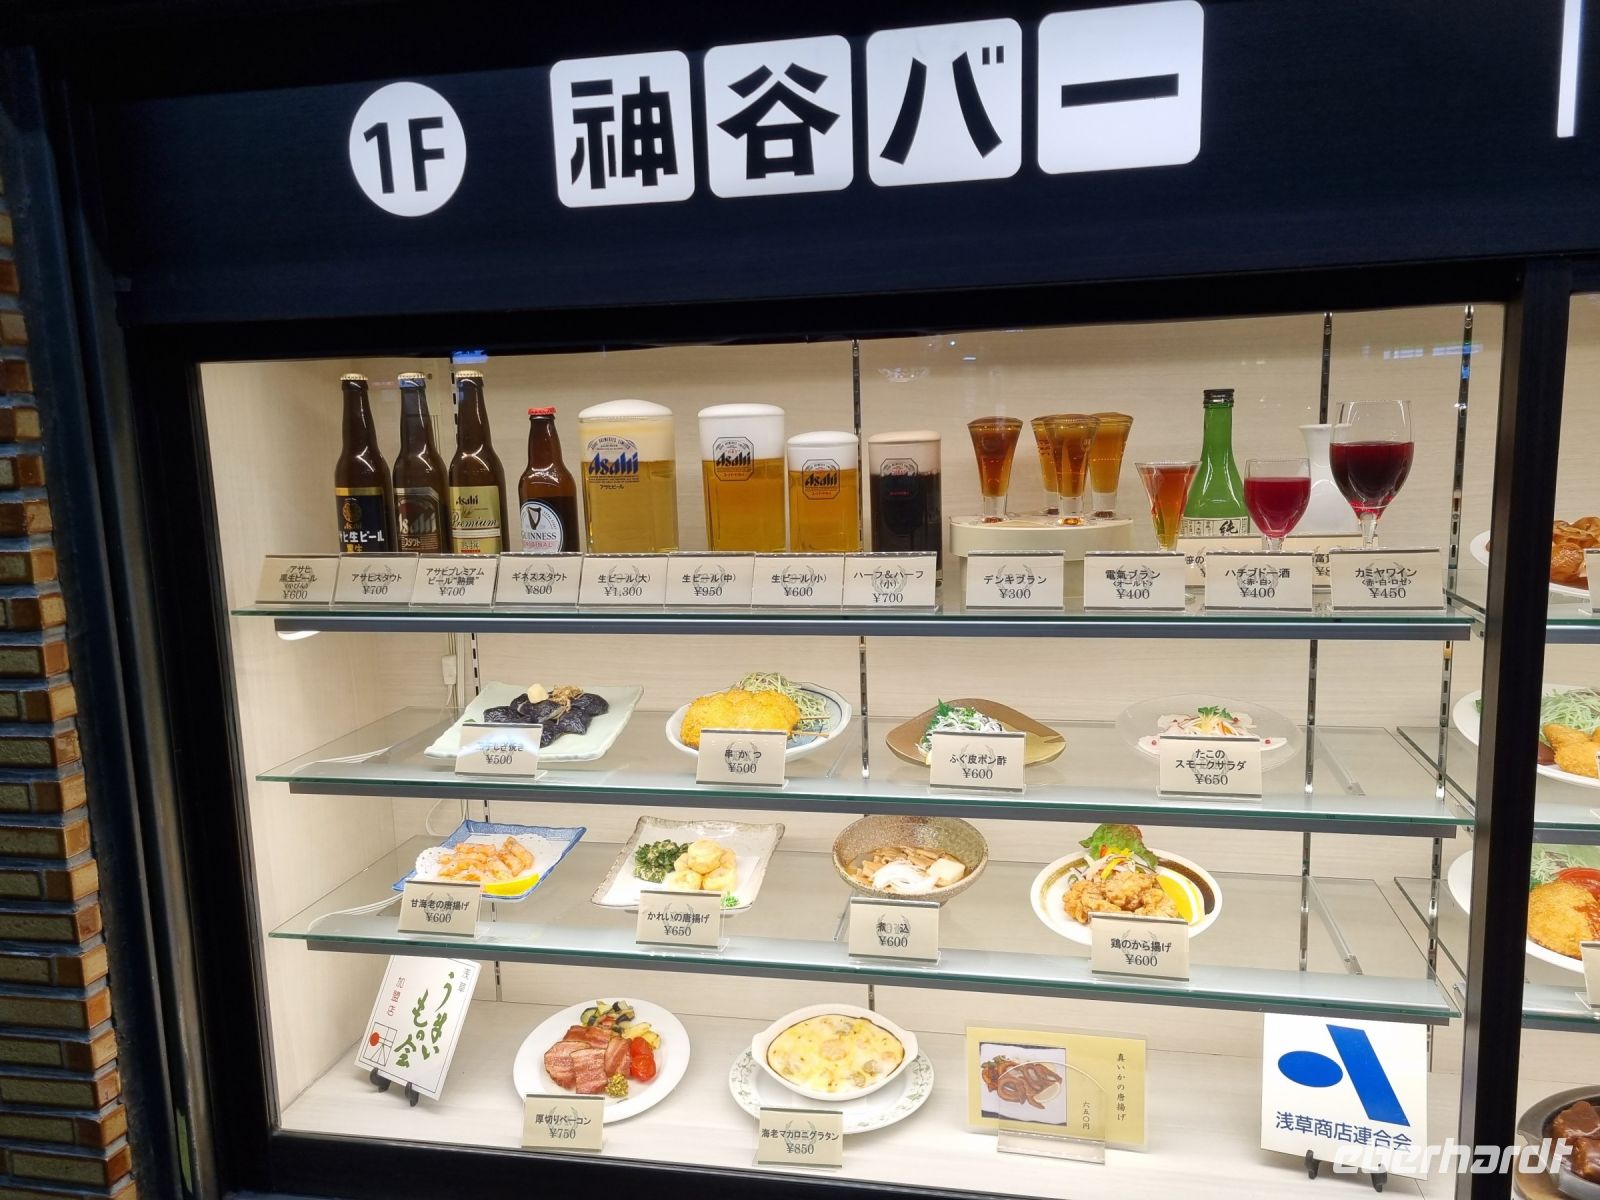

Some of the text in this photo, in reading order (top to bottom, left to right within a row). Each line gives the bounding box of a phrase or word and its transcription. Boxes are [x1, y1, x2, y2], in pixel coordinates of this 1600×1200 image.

[570, 45, 1179, 191] 神谷バー
[363, 116, 446, 194] 1F
[588, 452, 640, 475] Asahi
[716, 451, 751, 467] Asahi
[804, 472, 838, 487] Asahi
[455, 494, 479, 505] Asahi
[451, 511, 497, 528] Premium
[290, 565, 313, 574] アサヒ
[426, 568, 484, 576] アサヒプレミアム
[1225, 567, 1291, 578] ハチブドー酒
[1355, 567, 1418, 578] カミヤワイン
[279, 573, 318, 582] 黒生ビール
[352, 573, 402, 582] アサヒスタウト
[512, 573, 567, 583] ギネススタウト
[598, 574, 651, 584] 生ビール(大)
[682, 574, 736, 583] 生ビール(中)
[771, 574, 827, 584] 生ビール(小)
[983, 574, 1047, 585] デンキブラン
[282, 590, 308, 600] ¥600
[362, 585, 388, 595] ¥700
[439, 587, 466, 597] ¥700
[525, 585, 552, 595] ¥800
[693, 586, 723, 597] ¥950
[784, 586, 813, 597] ¥600
[998, 588, 1031, 600] ¥300
[1115, 588, 1150, 600] ¥400
[1239, 587, 1276, 599] ¥400
[1369, 587, 1407, 599] ¥450
[872, 592, 903, 603] ¥700
[485, 754, 513, 765] ¥500
[949, 754, 1007, 766] ふぐ皮ポン酢
[1194, 748, 1226, 760] たこの
[727, 762, 758, 774] ¥500
[1175, 759, 1247, 772] スモークサラダ
[962, 768, 994, 780] ¥600
[1193, 773, 1229, 786] ¥650
[411, 898, 470, 912] 甘海老の唐揚げ
[425, 911, 452, 924] ¥600
[647, 911, 710, 925] かれいの唐揚げ
[663, 925, 692, 937] ¥650
[878, 935, 909, 948] ¥600
[1110, 938, 1172, 953] 鶏のから揚げ
[1124, 953, 1158, 967] ¥600
[1116, 1052, 1127, 1122] 真いかの唐揚げ
[534, 1113, 592, 1126] 厚切りベーコン
[549, 1127, 576, 1140] ¥750
[761, 1127, 840, 1142] 海老マカロニグラタン
[1275, 1110, 1413, 1153] 浅草商店連合会
[785, 1142, 814, 1155] ¥850
